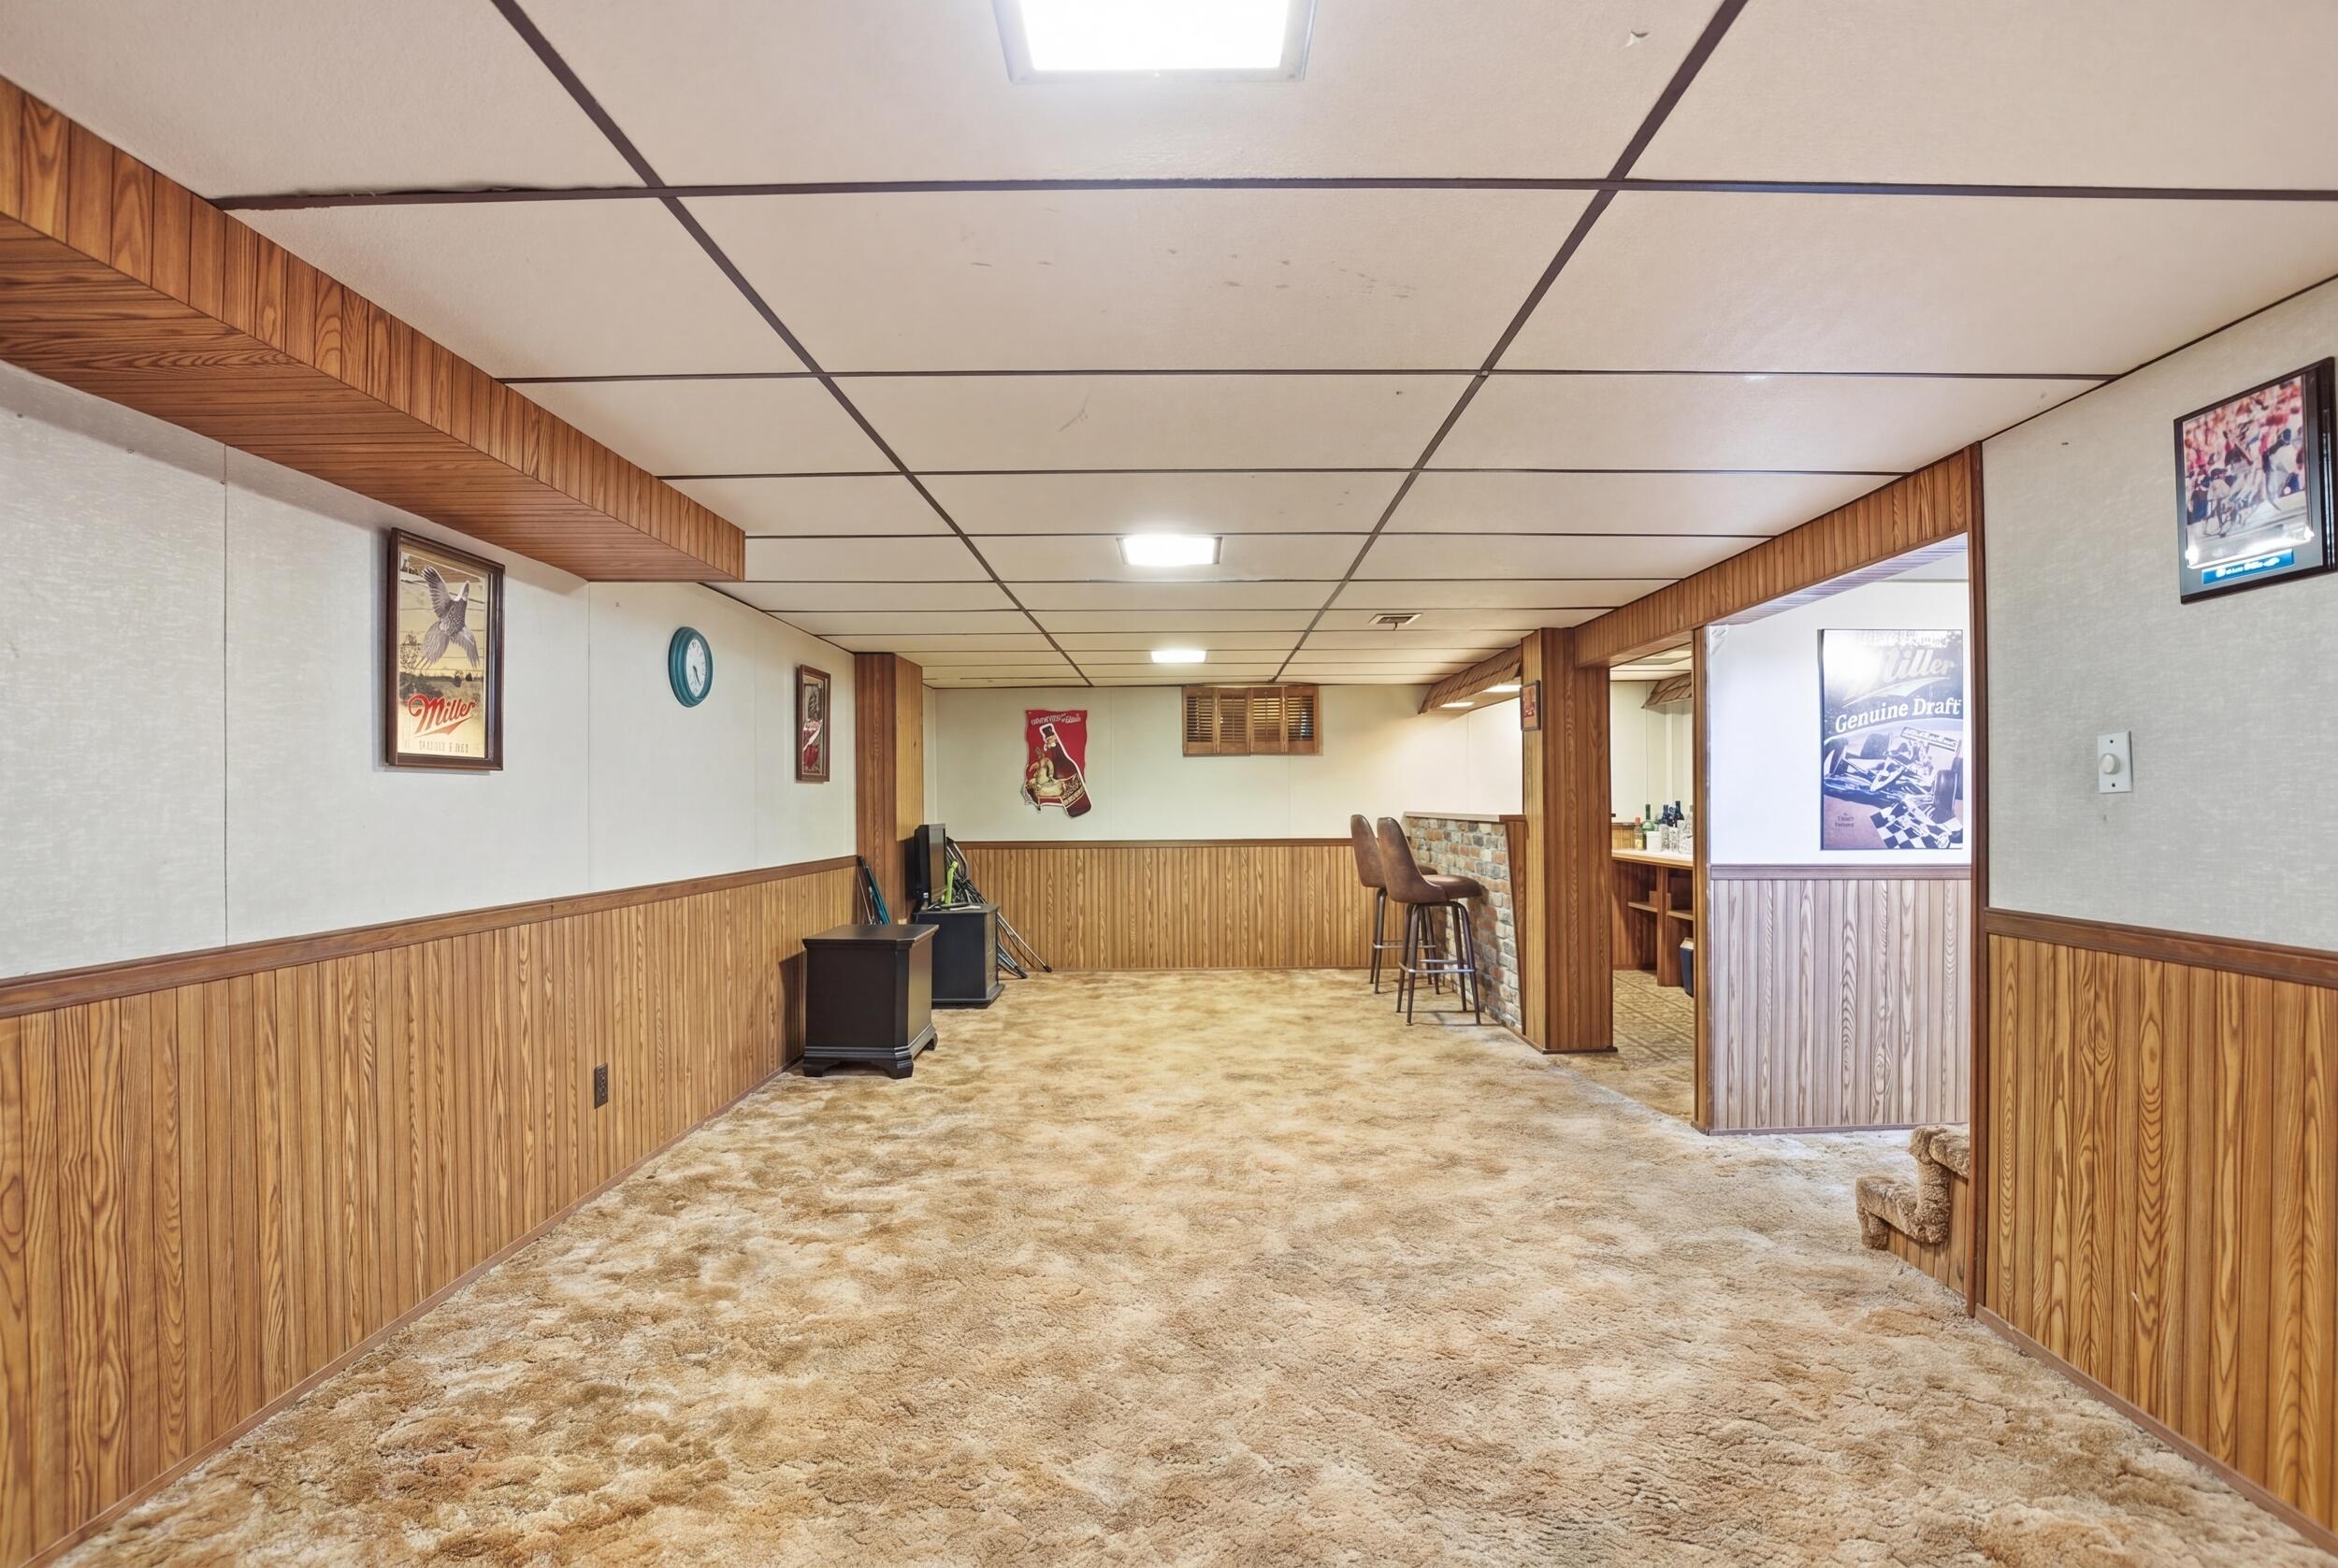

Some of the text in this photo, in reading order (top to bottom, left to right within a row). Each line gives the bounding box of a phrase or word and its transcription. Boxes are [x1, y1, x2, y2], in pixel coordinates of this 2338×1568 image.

[408, 693, 477, 734] Miller
[1835, 697, 1961, 733] Genuine Draft
